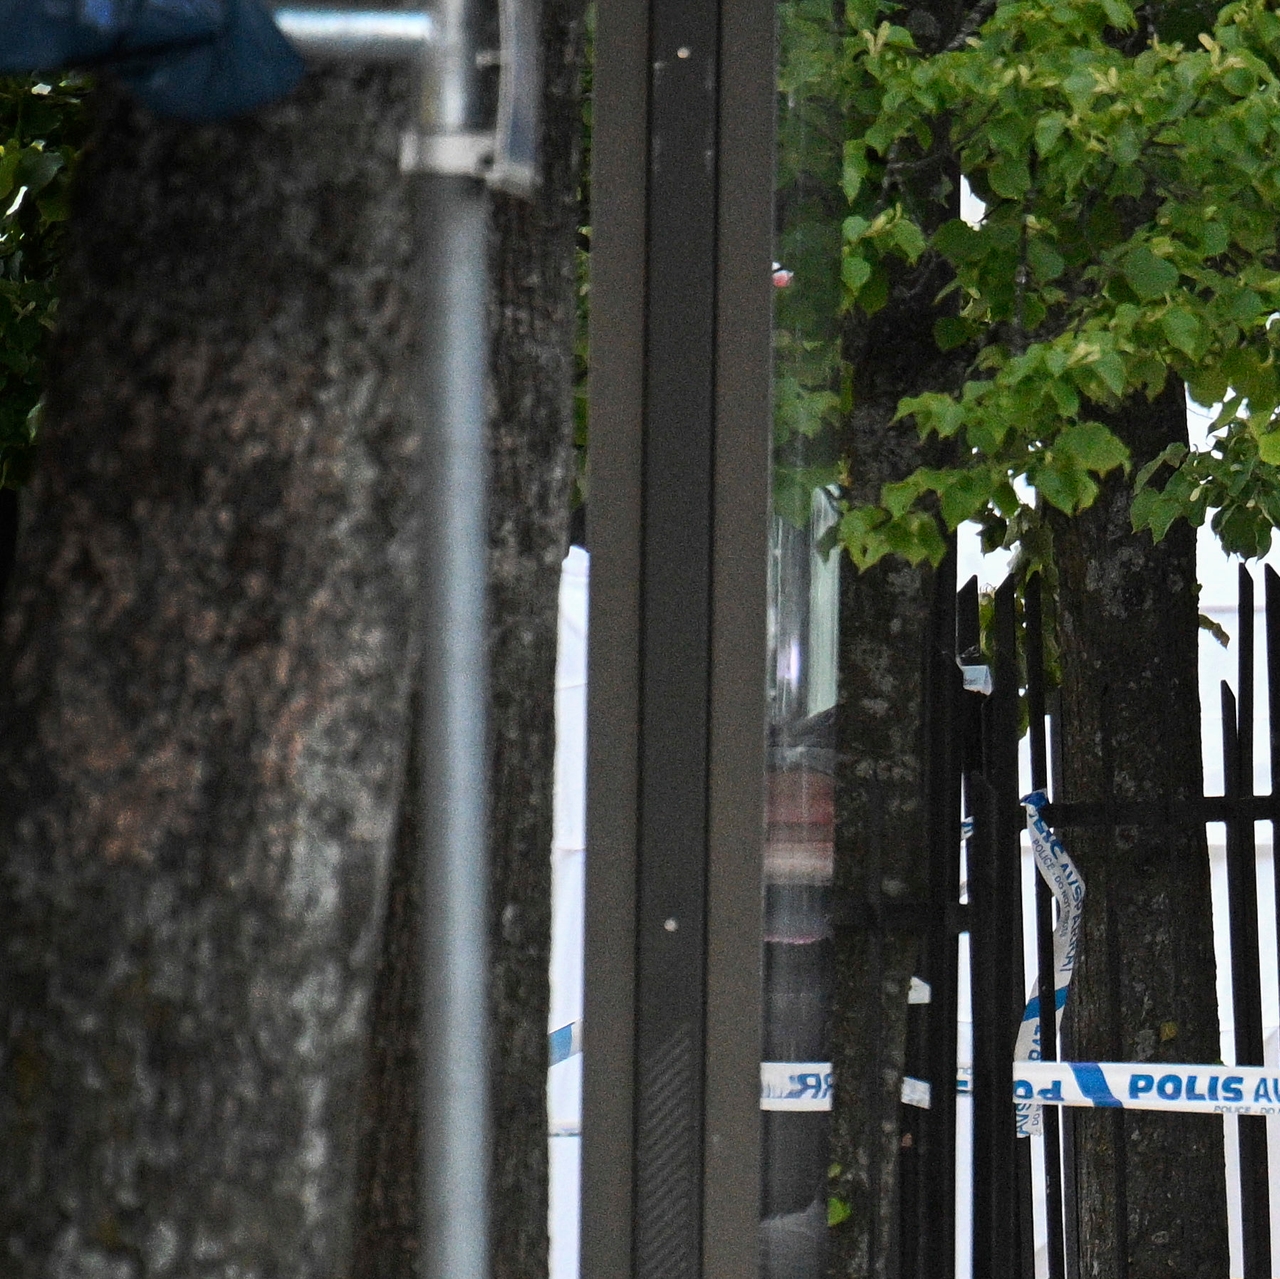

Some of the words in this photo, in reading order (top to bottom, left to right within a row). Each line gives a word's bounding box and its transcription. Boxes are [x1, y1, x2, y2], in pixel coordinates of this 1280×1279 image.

[1032, 838, 1056, 871] POLICE
[1055, 876, 1065, 890] DO
[1128, 1074, 1245, 1102] POLIS
